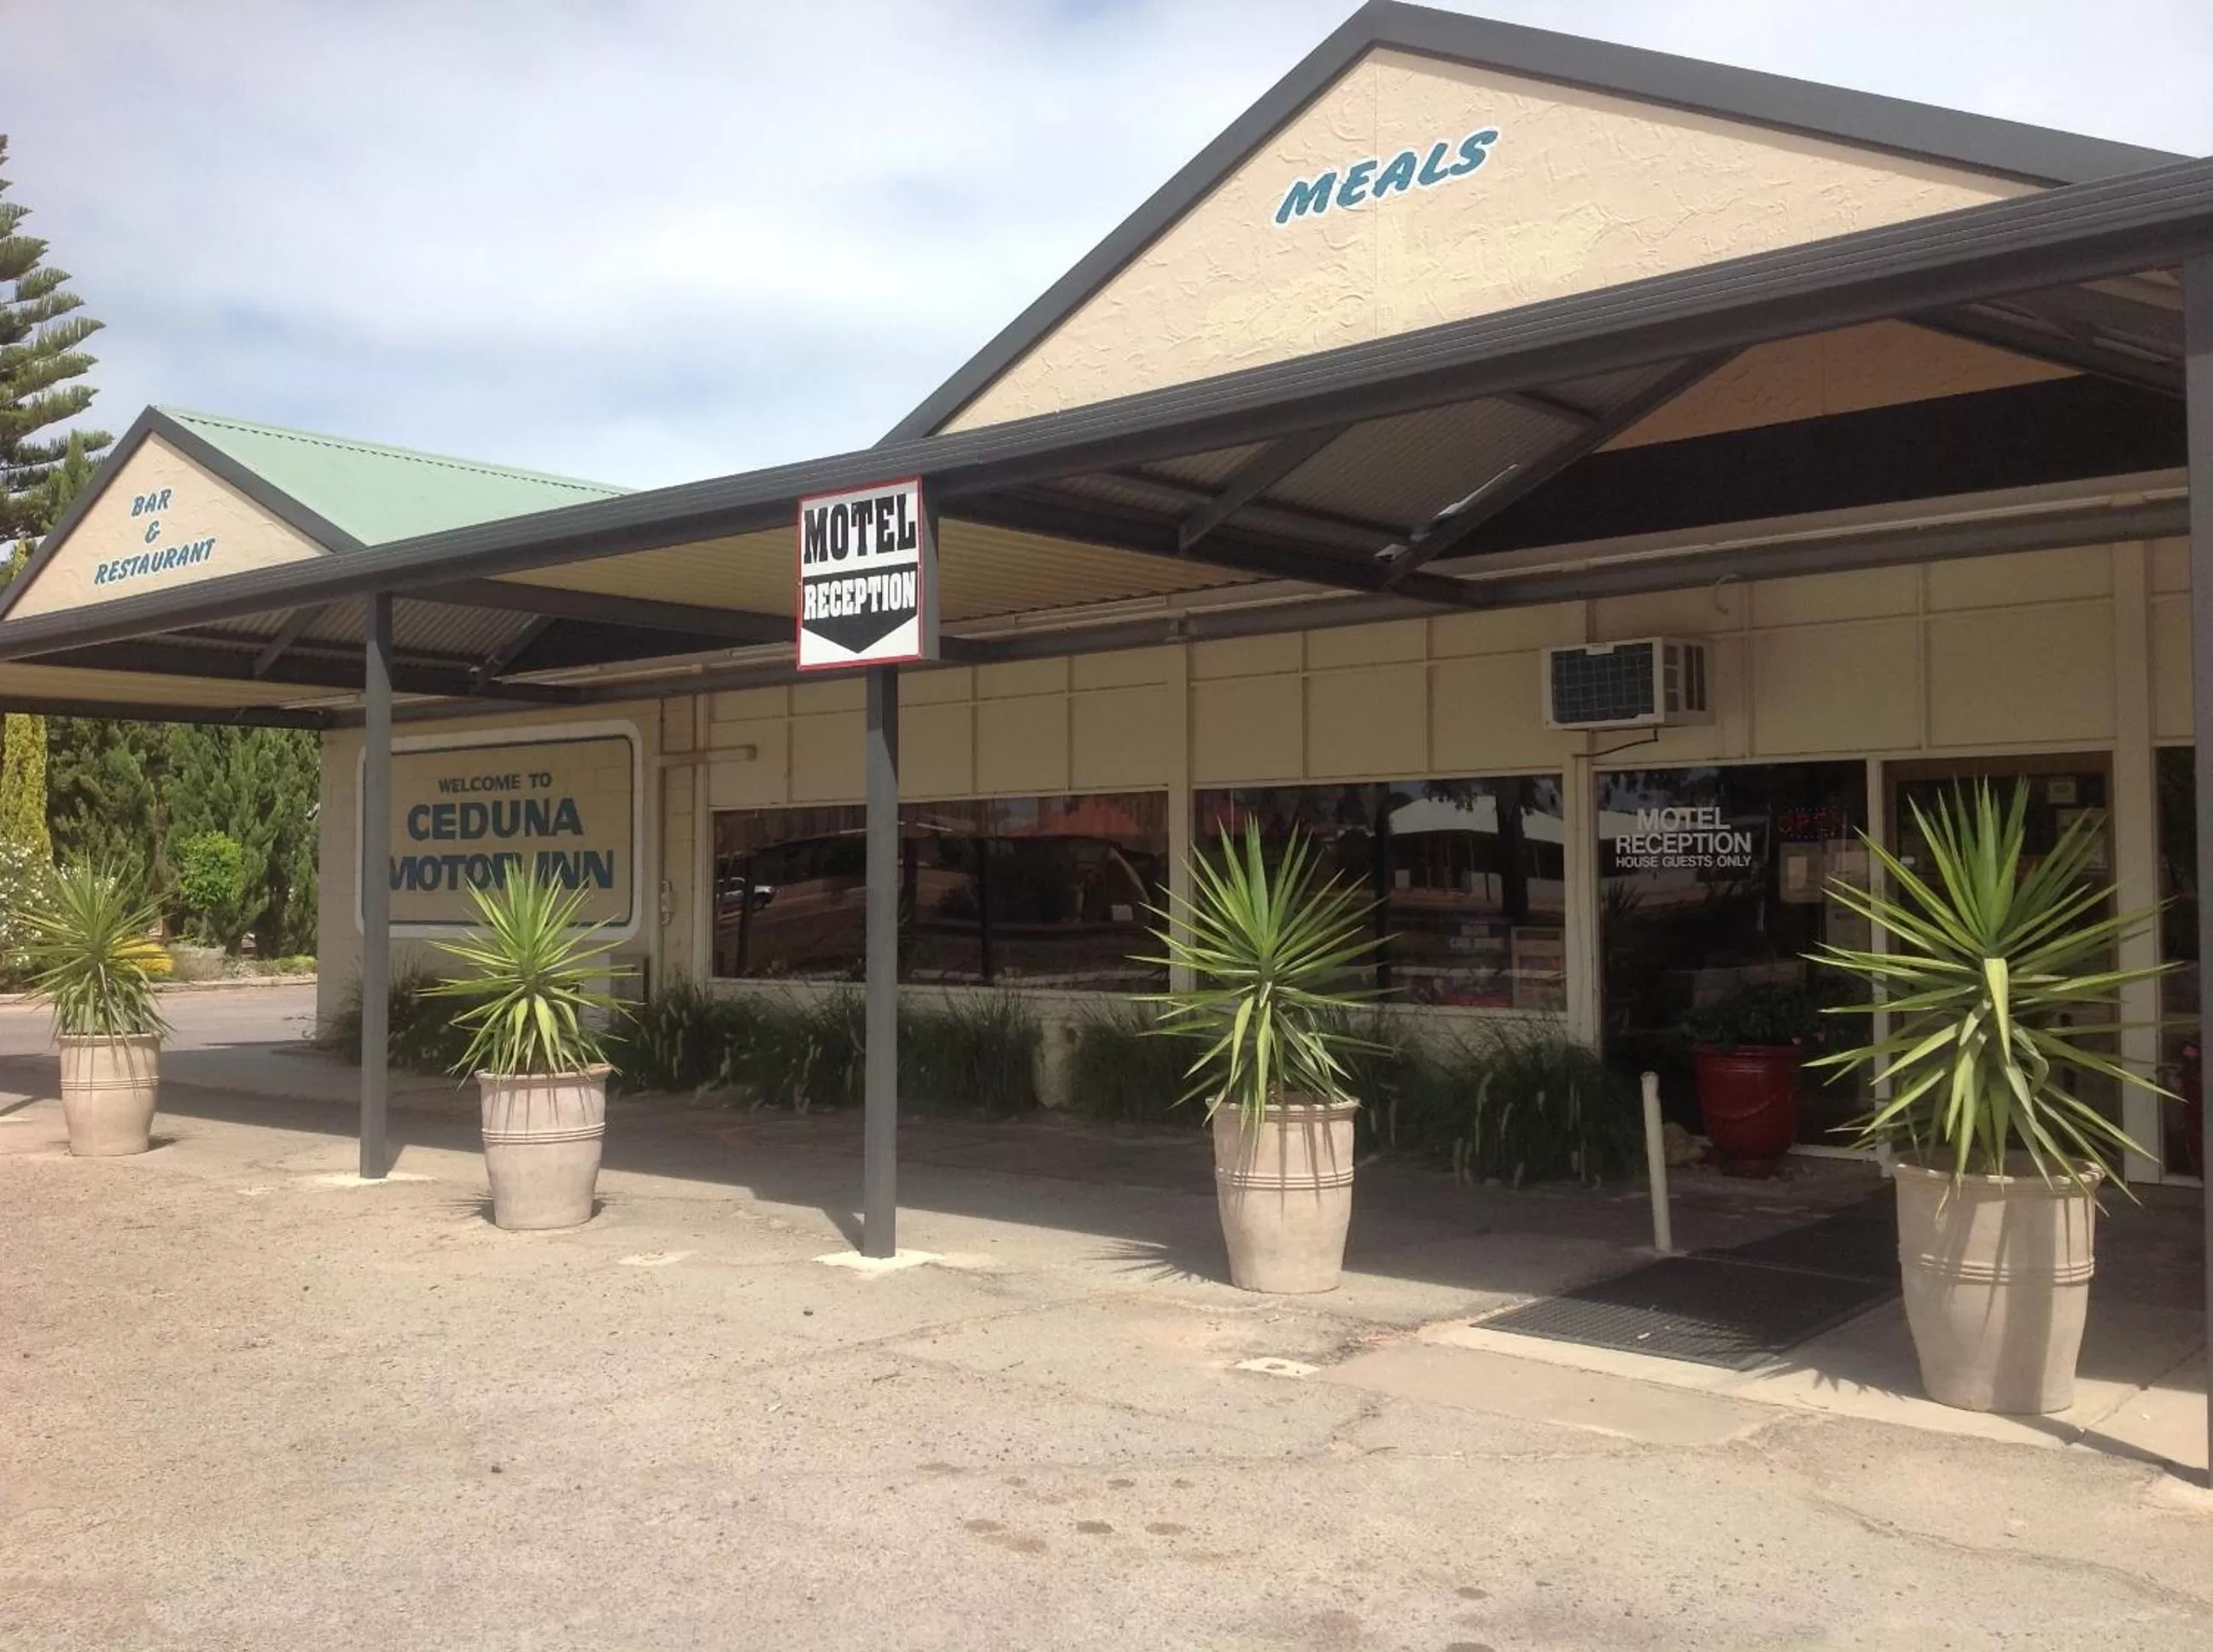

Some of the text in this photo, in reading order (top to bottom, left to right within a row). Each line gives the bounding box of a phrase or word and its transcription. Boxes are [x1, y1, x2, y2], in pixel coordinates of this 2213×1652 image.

[1274, 128, 1500, 225] MEALS
[131, 487, 173, 518] BAR
[143, 519, 161, 545] &
[803, 493, 916, 564] MOTEL
[93, 537, 217, 586] RESTAURANT
[803, 570, 916, 621] RECEPTION
[438, 772, 553, 793] WELCOME TO
[407, 797, 584, 842] CEDUNA
[1636, 806, 1732, 831] MOTEL
[1615, 832, 1751, 855] RECEPTION
[537, 849, 615, 890] INN
[1615, 855, 1751, 869] HOUSE GUESTS ONLY
